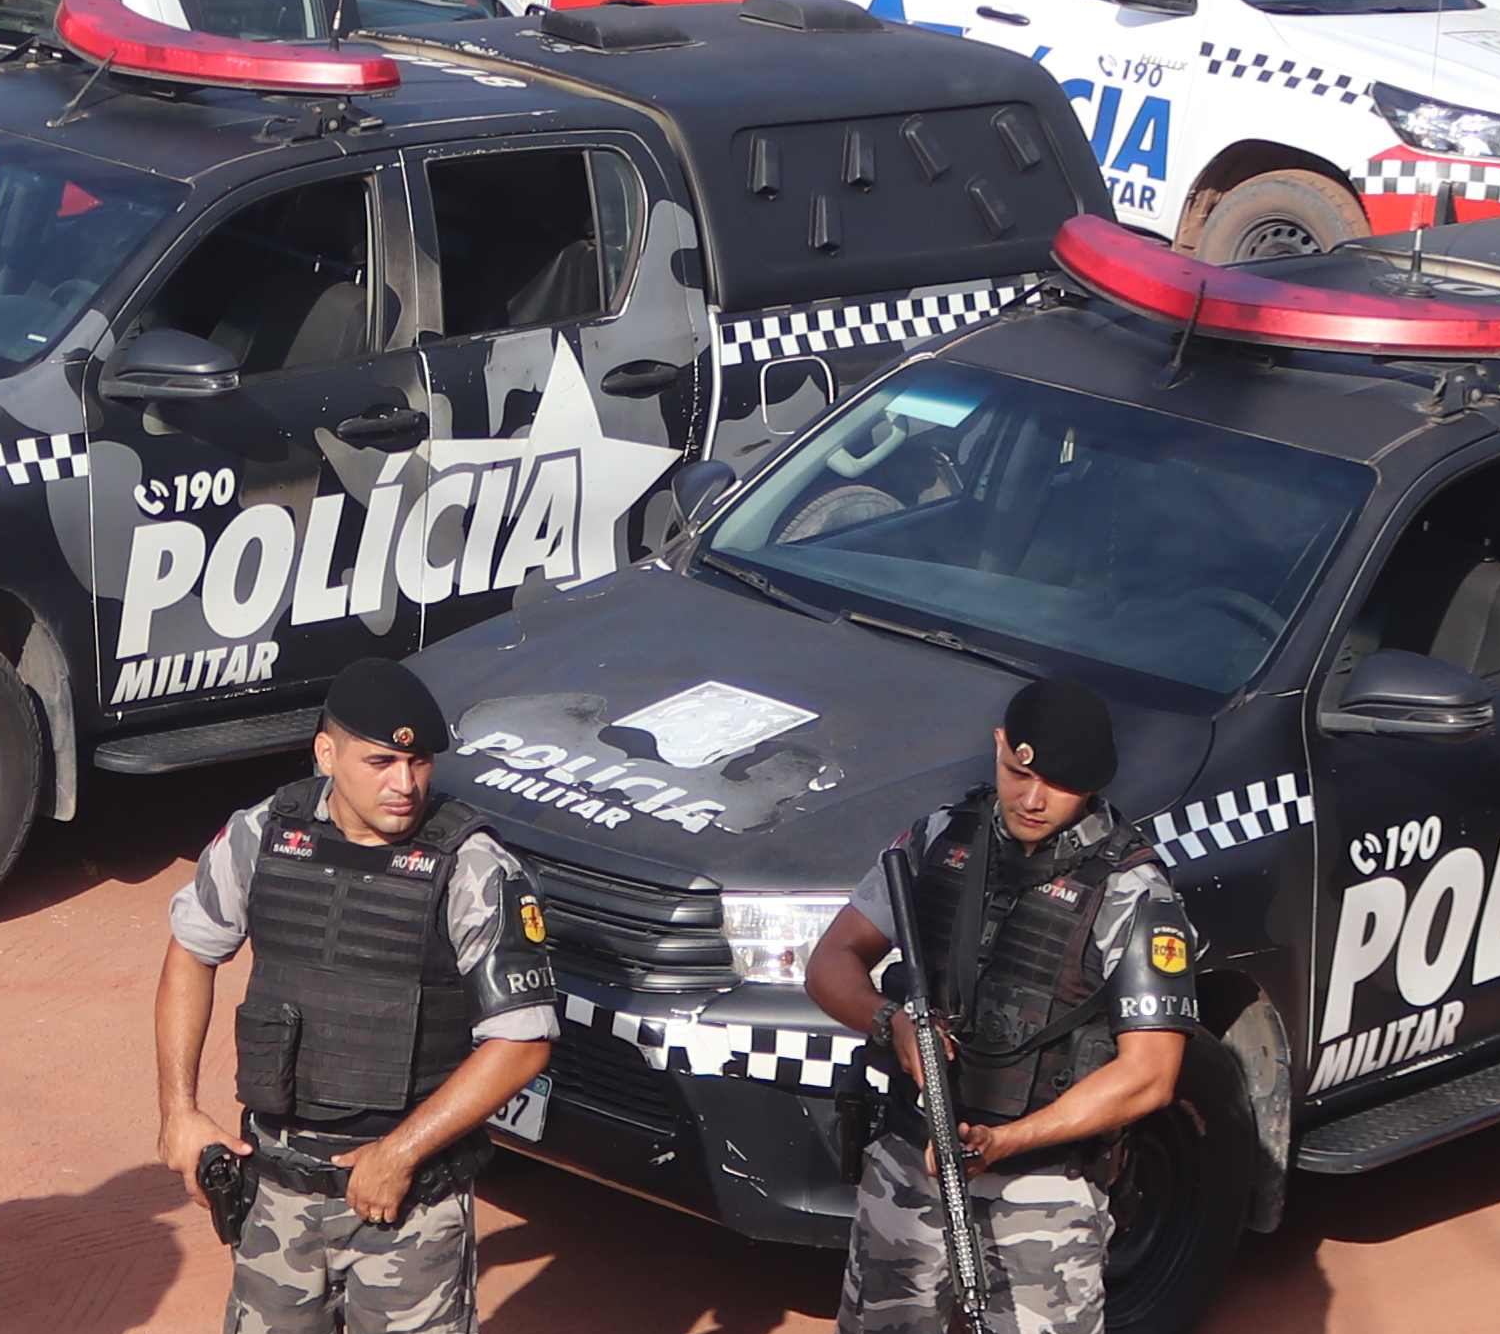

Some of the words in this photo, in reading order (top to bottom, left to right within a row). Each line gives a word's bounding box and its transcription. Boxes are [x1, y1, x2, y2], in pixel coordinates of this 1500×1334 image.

[1121, 58, 1164, 88] 190
[173, 467, 236, 512] 190
[116, 449, 583, 661] POLÍCIA
[110, 640, 280, 706] MILITAR
[458, 728, 729, 835] POLÍCIA
[476, 767, 629, 829] MILITAR
[272, 842, 313, 858] SANTIAGO
[1385, 815, 1442, 867] 190
[390, 853, 436, 874] ROTAM
[1033, 881, 1079, 904] OTAM
[1153, 926, 1186, 939] PMPA
[506, 966, 557, 995] ROT
[1119, 995, 1200, 1023] ROTA
[1306, 999, 1464, 1098] MILITAR
